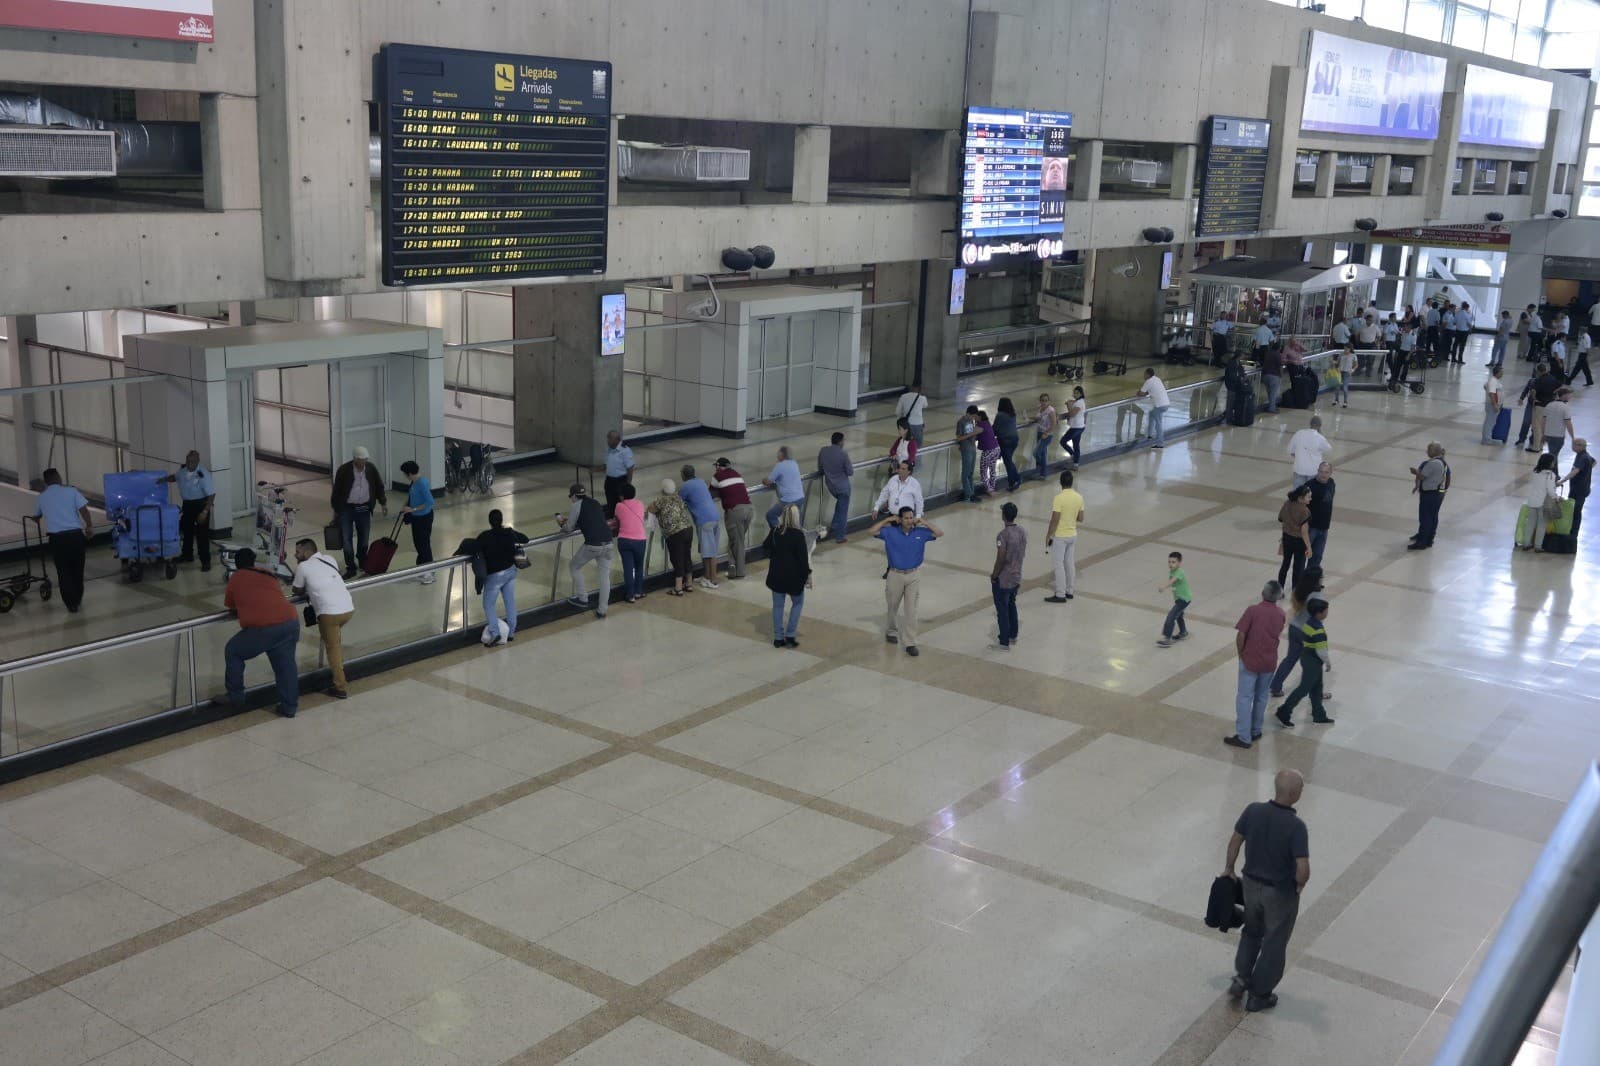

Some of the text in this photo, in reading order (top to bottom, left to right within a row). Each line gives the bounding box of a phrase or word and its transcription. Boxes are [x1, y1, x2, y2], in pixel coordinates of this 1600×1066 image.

[520, 65, 558, 80] Llegadas
[522, 81, 552, 94] Arrivals
[432, 110, 456, 120] PUNTA
[460, 112, 480, 120] CANA
[432, 126, 456, 134] MIAMI
[432, 168, 460, 176] PANAMA
[432, 197, 460, 205] BOGOTA
[432, 211, 456, 220] SANTO
[432, 240, 460, 248] MADRID
